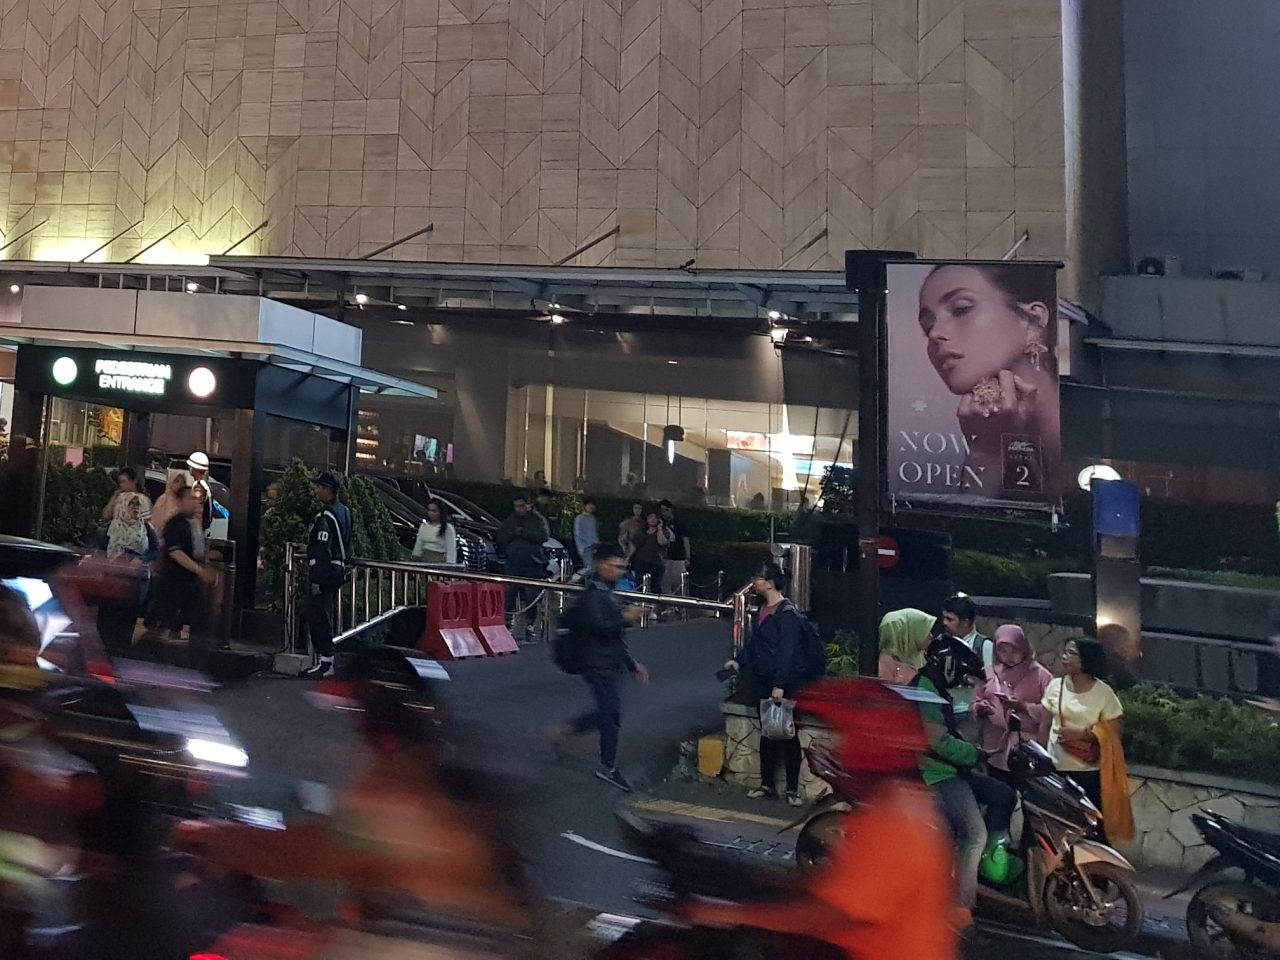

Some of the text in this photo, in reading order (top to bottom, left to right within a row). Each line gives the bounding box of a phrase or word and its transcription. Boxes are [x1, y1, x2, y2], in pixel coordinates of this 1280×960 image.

[99, 374, 165, 394] ENTRANCE
[899, 430, 978, 455] NOW
[899, 461, 985, 488] OPEN
[1016, 465, 1030, 486] 2
